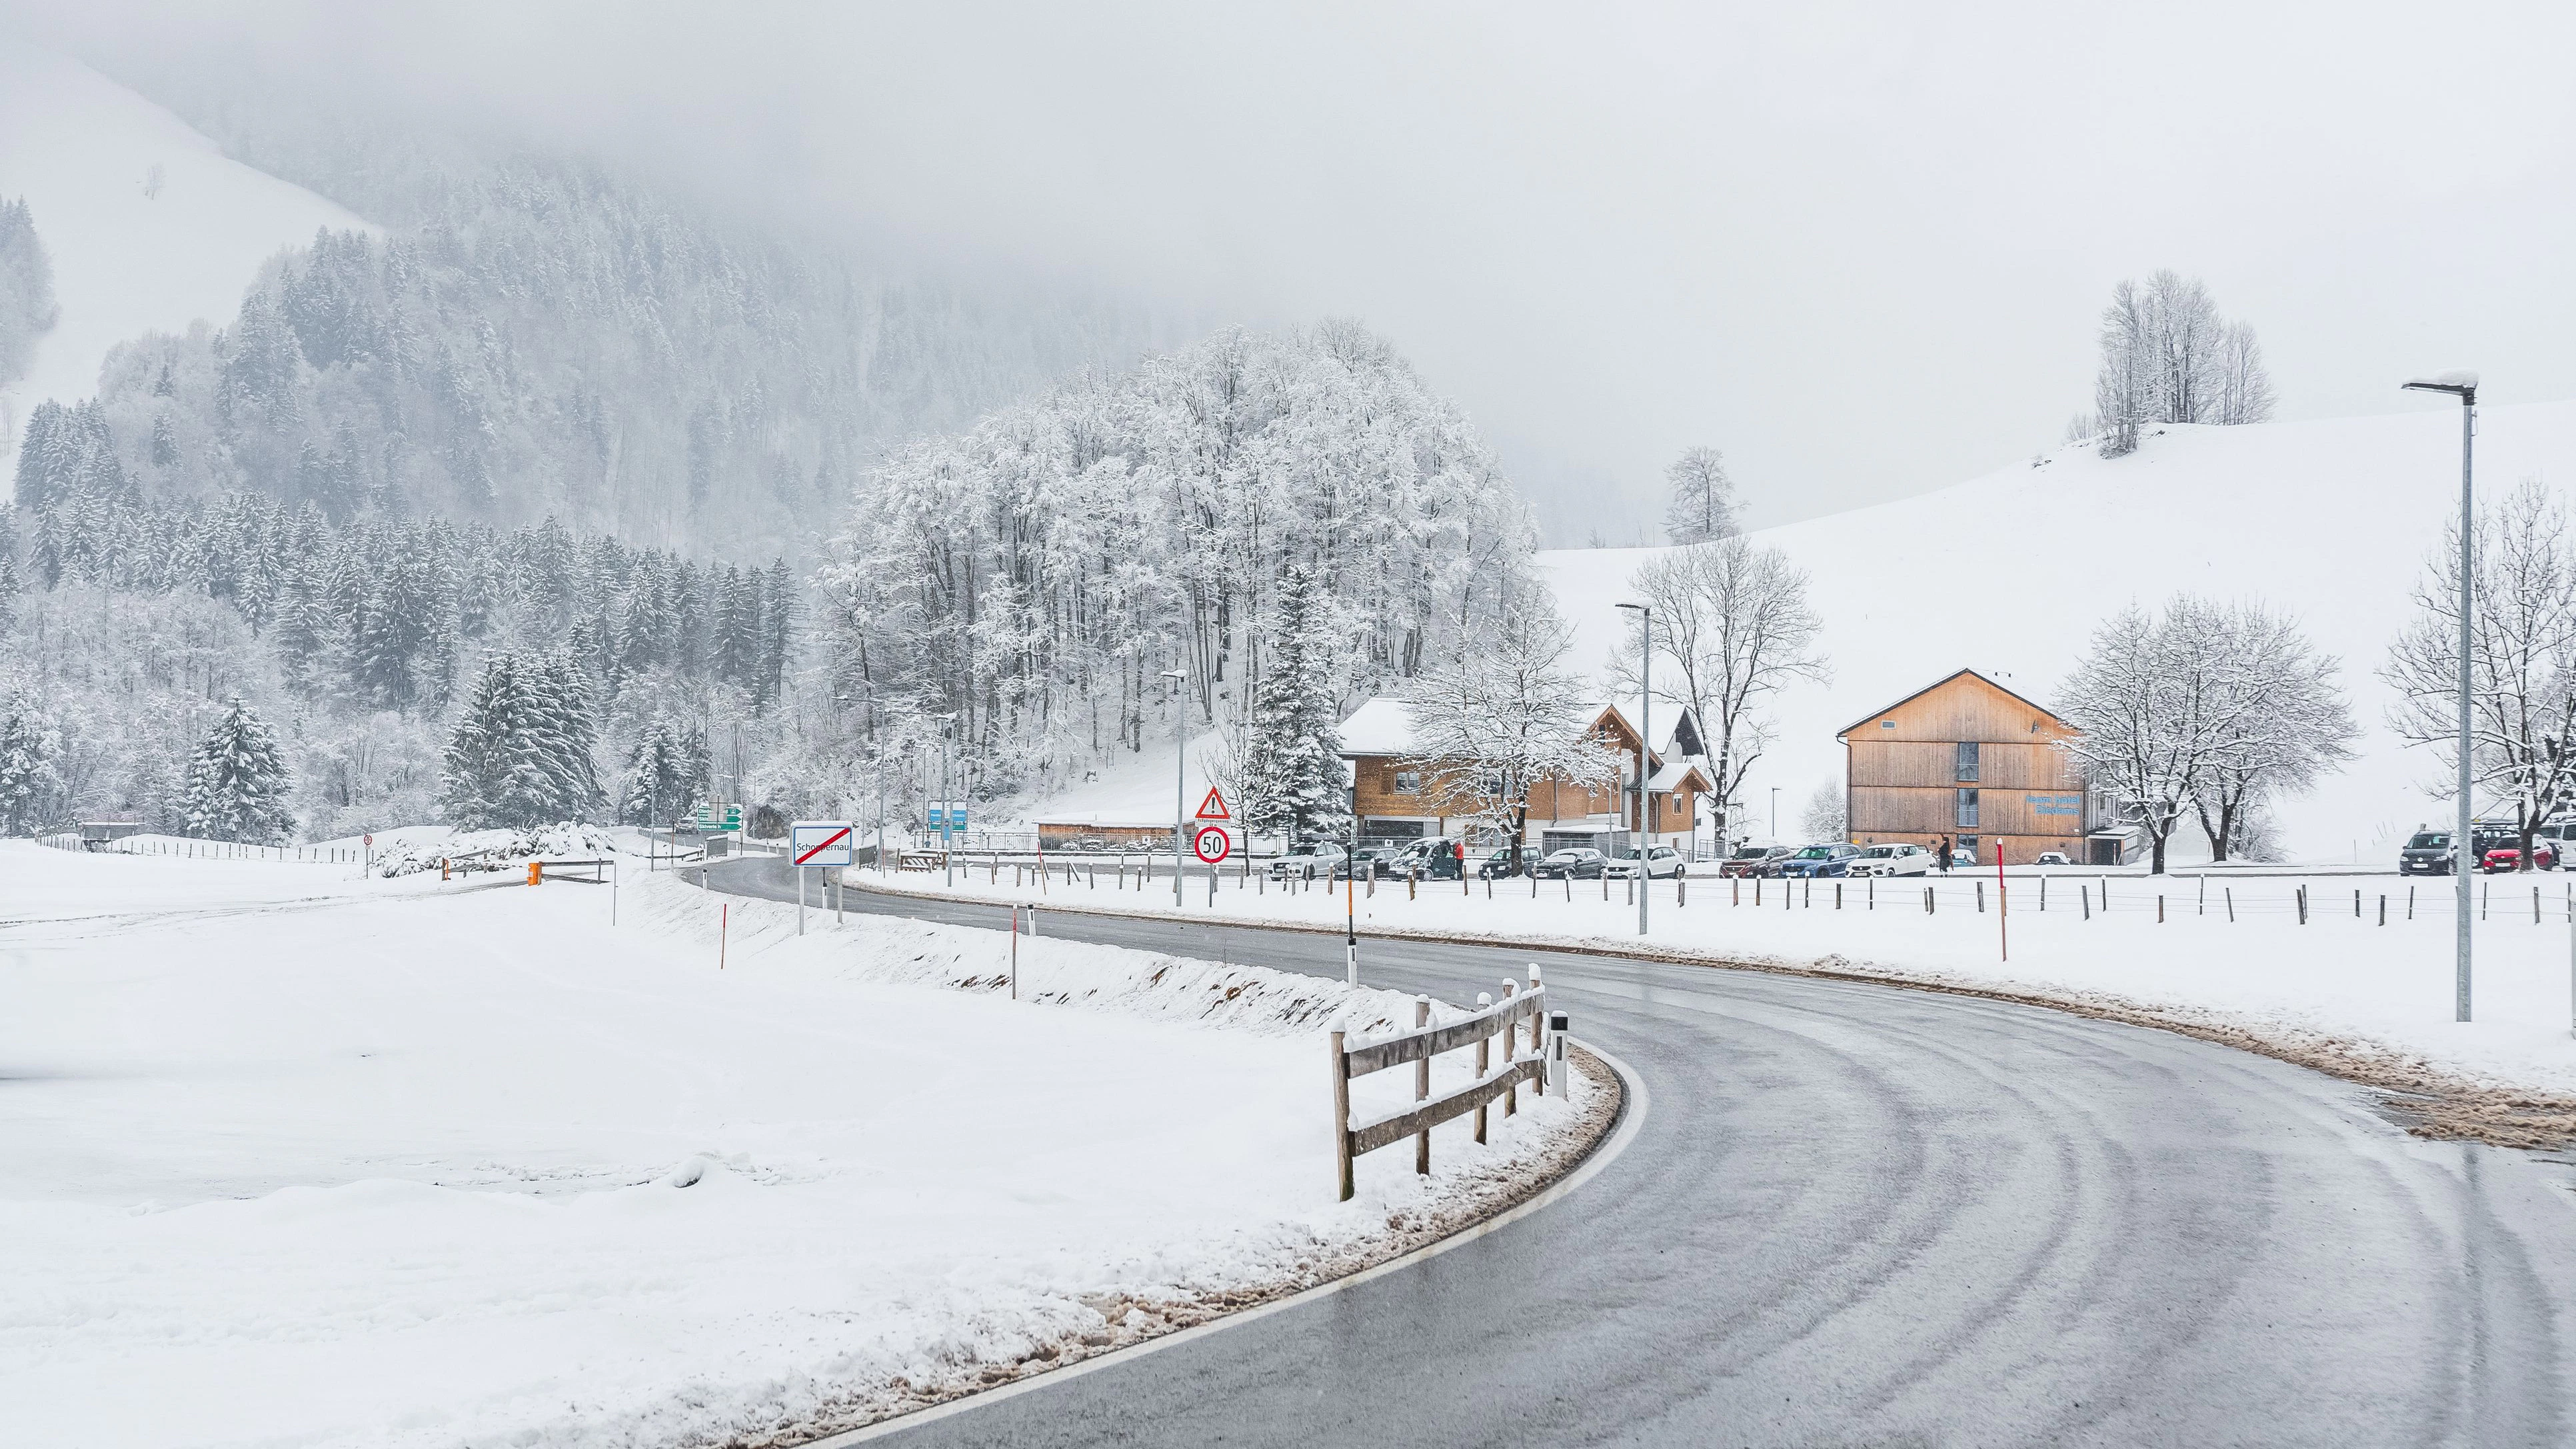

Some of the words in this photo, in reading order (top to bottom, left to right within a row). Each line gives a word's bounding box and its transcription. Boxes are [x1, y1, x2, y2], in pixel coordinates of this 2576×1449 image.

[2055, 794, 2079, 804] hotel
[2036, 805, 2079, 814] Diedams
[796, 843, 849, 852] Schopernau
[1203, 836, 1222, 854] 50
